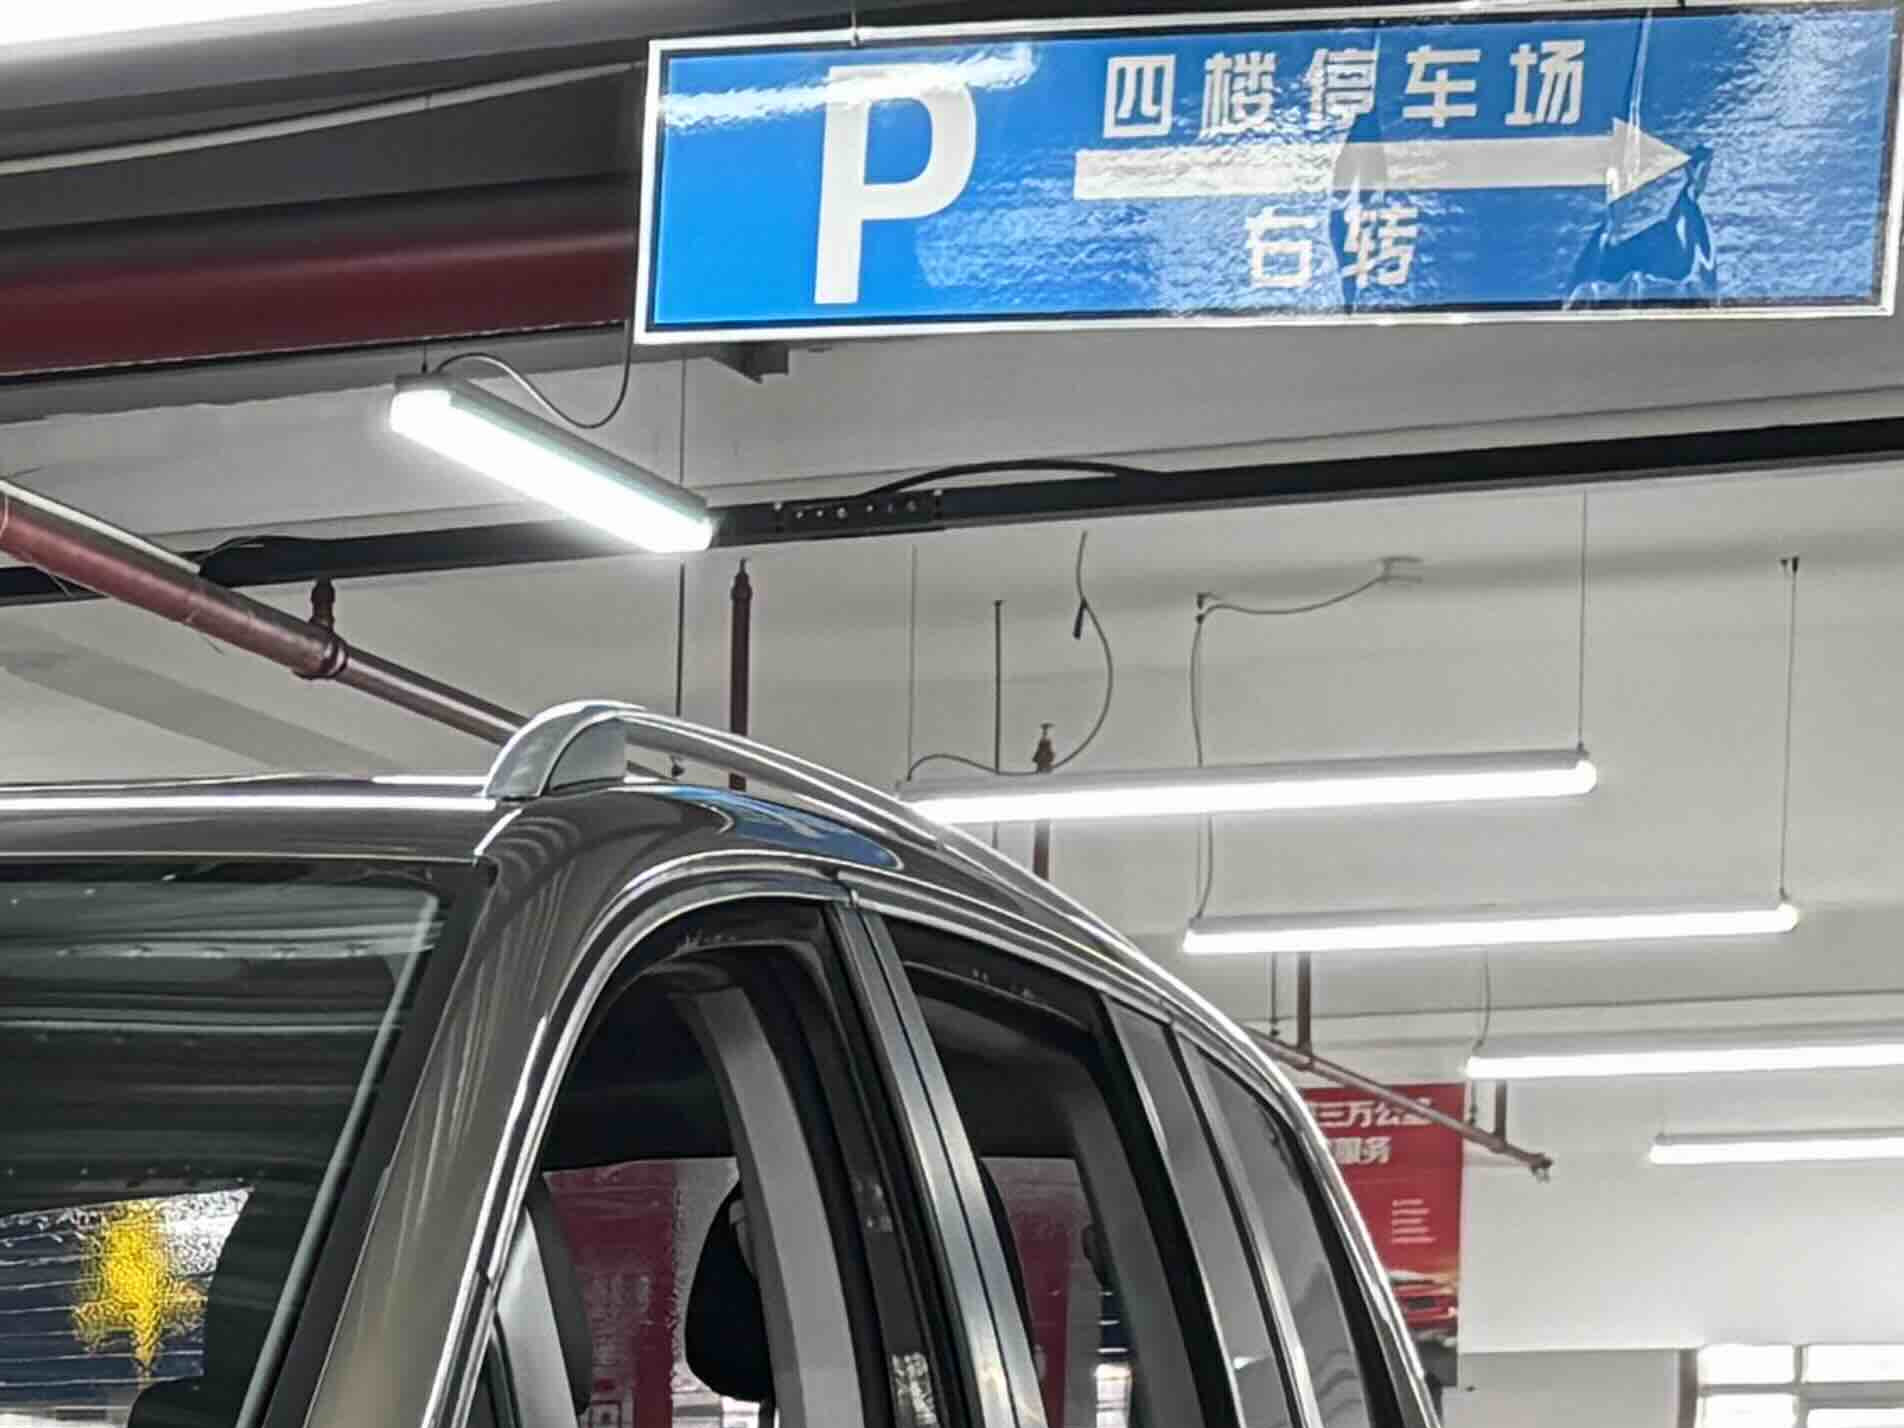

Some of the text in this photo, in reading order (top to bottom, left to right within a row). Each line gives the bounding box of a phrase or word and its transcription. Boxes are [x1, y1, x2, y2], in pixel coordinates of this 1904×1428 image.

[1102, 38, 1586, 138] 四楼停车场
[812, 63, 978, 304] P
[1244, 200, 1419, 290] 右转
